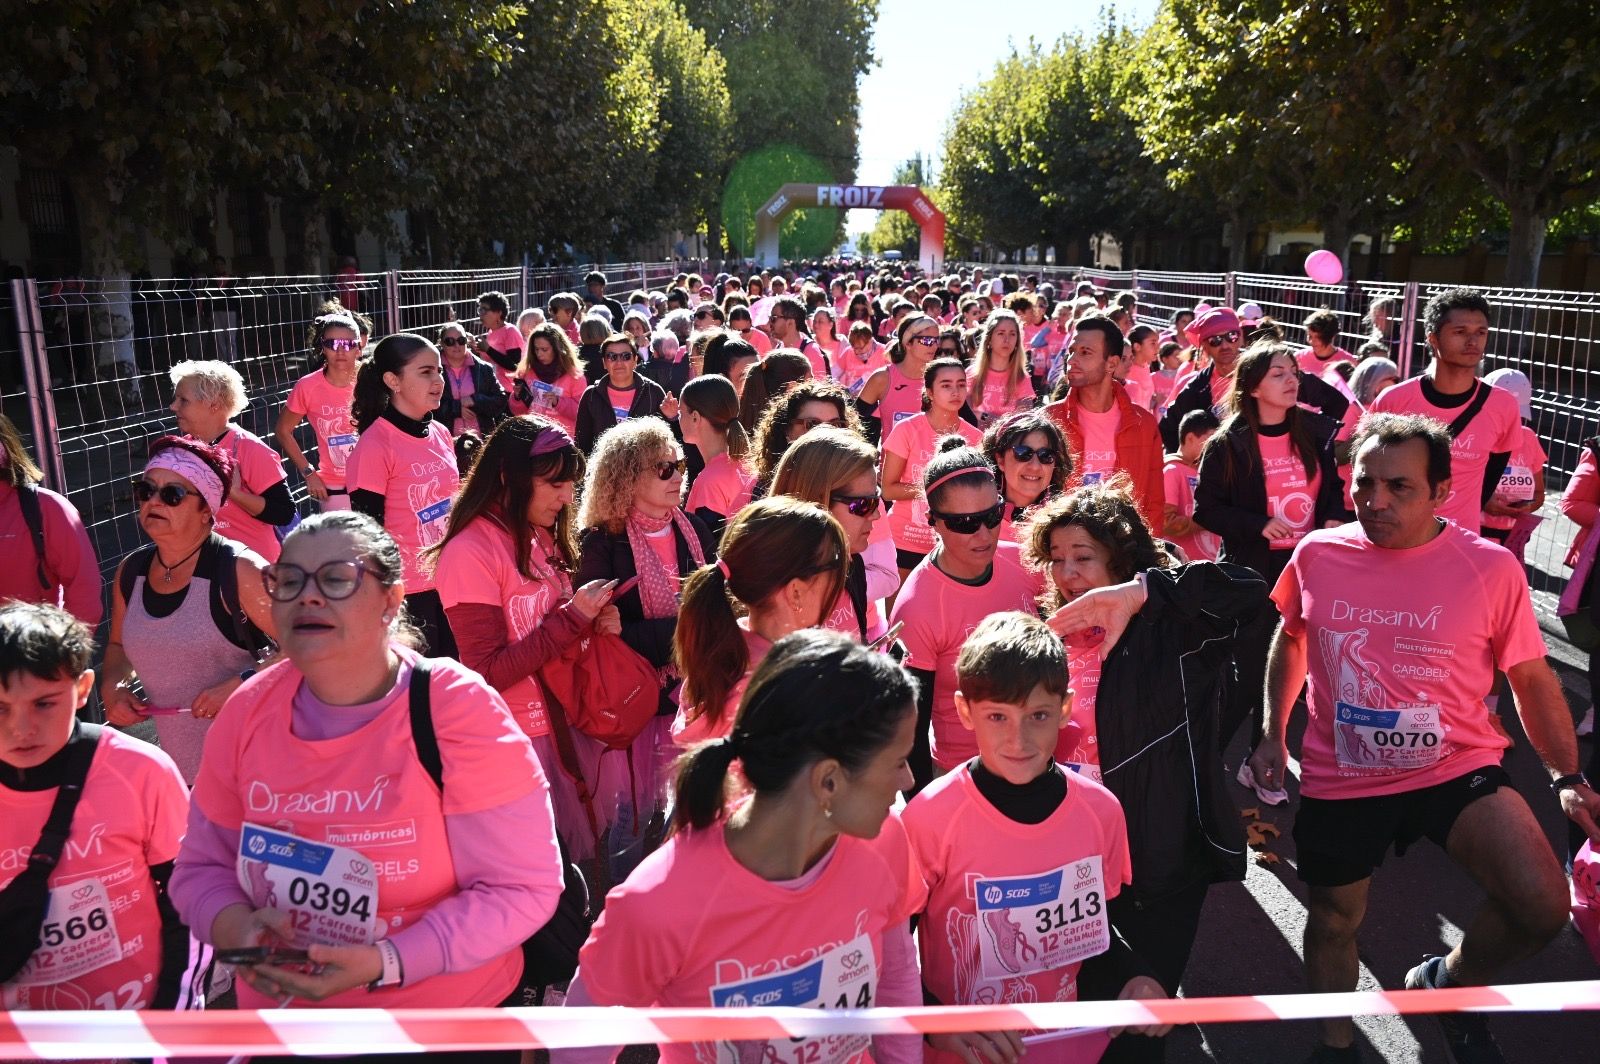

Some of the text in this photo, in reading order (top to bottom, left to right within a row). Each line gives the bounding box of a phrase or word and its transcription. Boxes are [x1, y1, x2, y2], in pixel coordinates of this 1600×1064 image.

[816, 185, 885, 207] FROIZ
[1501, 476, 1533, 486] 2890
[1331, 600, 1443, 631] Drasanvi
[1392, 664, 1451, 678] CAROBELS
[1373, 730, 1438, 748] 0070
[249, 775, 390, 815] Drasanvi
[248, 834, 266, 855] hp
[373, 858, 419, 876] BELS
[1073, 876, 1098, 890] almom
[288, 876, 371, 923] 0394
[984, 886, 1003, 904] hp
[1005, 888, 1031, 899] SCDS
[1035, 891, 1102, 934] 3113
[38, 907, 109, 948] 566
[316, 927, 328, 937] de
[329, 930, 338, 939] la
[318, 915, 367, 936] Carrera
[1063, 919, 1102, 937] Carrera
[60, 930, 111, 956] Carrera
[1063, 928, 1103, 946] de la Mujer
[838, 964, 870, 984] almom
